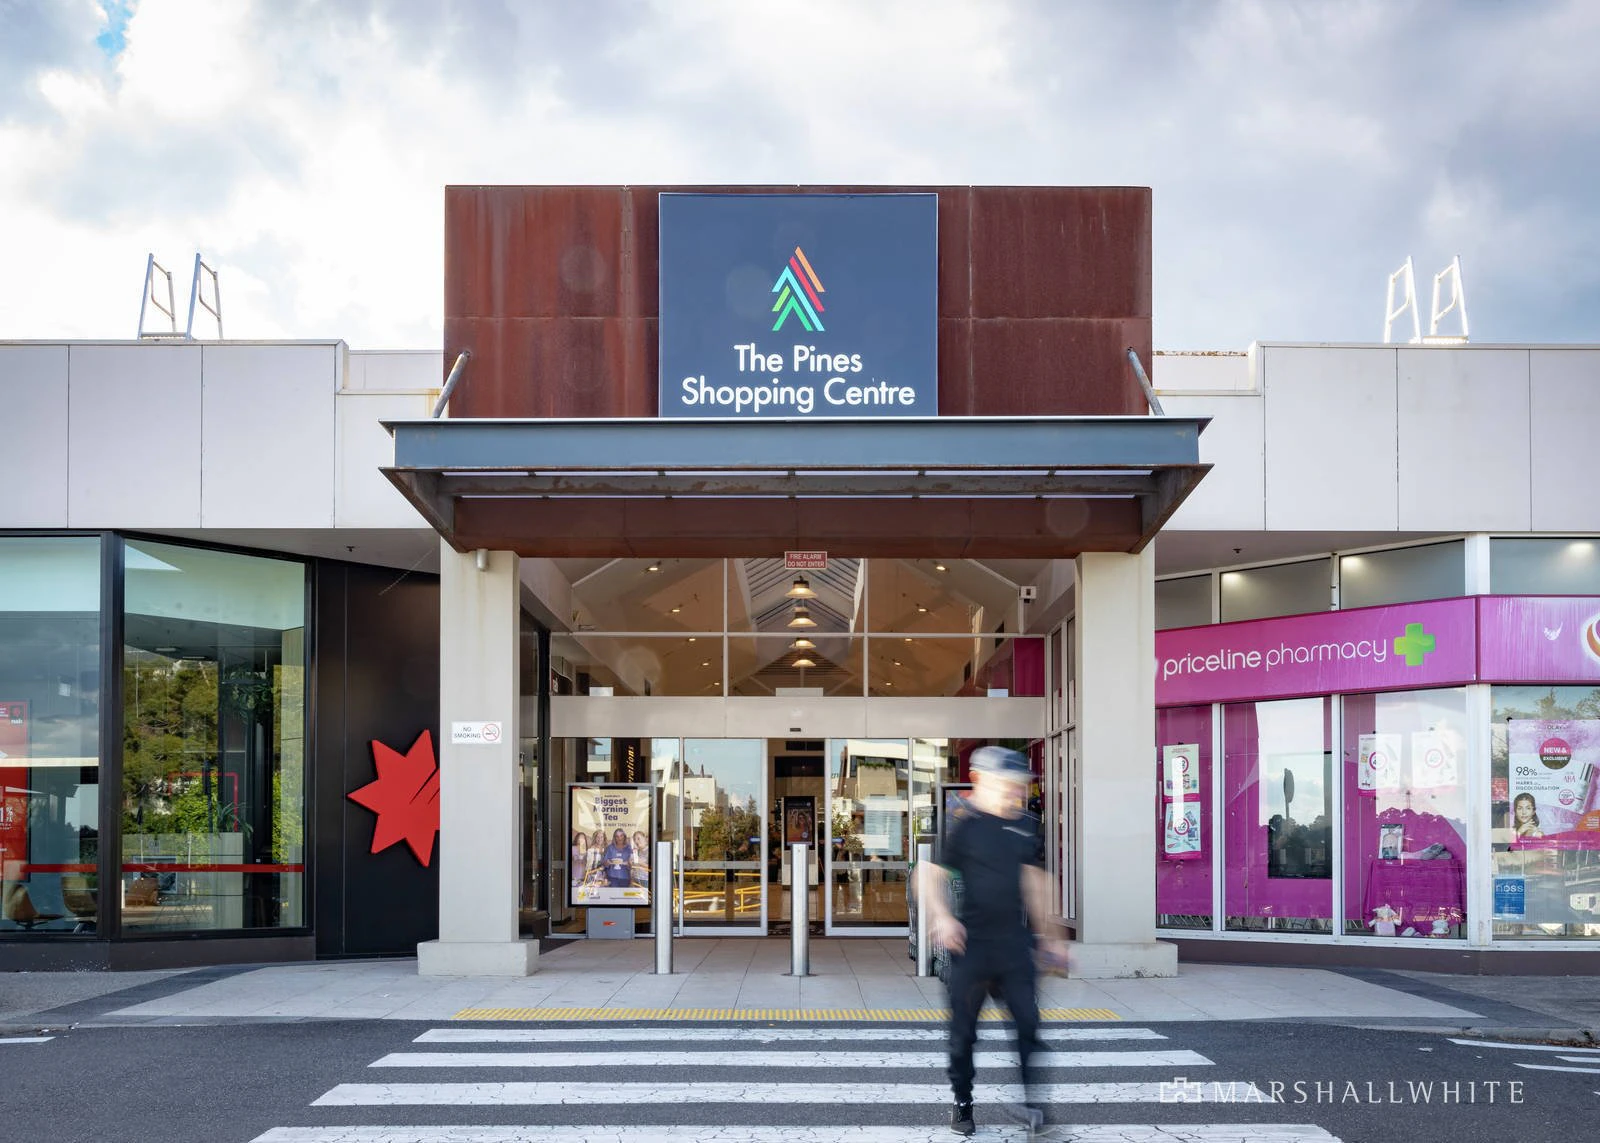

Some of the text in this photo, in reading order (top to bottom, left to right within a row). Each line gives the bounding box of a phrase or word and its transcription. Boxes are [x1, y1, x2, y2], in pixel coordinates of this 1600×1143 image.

[734, 343, 863, 373] The Pines
[681, 375, 916, 413] Shopping Centre
[1163, 639, 1387, 681] priceline pharmacy
[1543, 746, 1561, 754] NEW
[1515, 766, 1538, 776] 98%
[595, 797, 627, 806] Biggest
[603, 813, 618, 821] Tea
